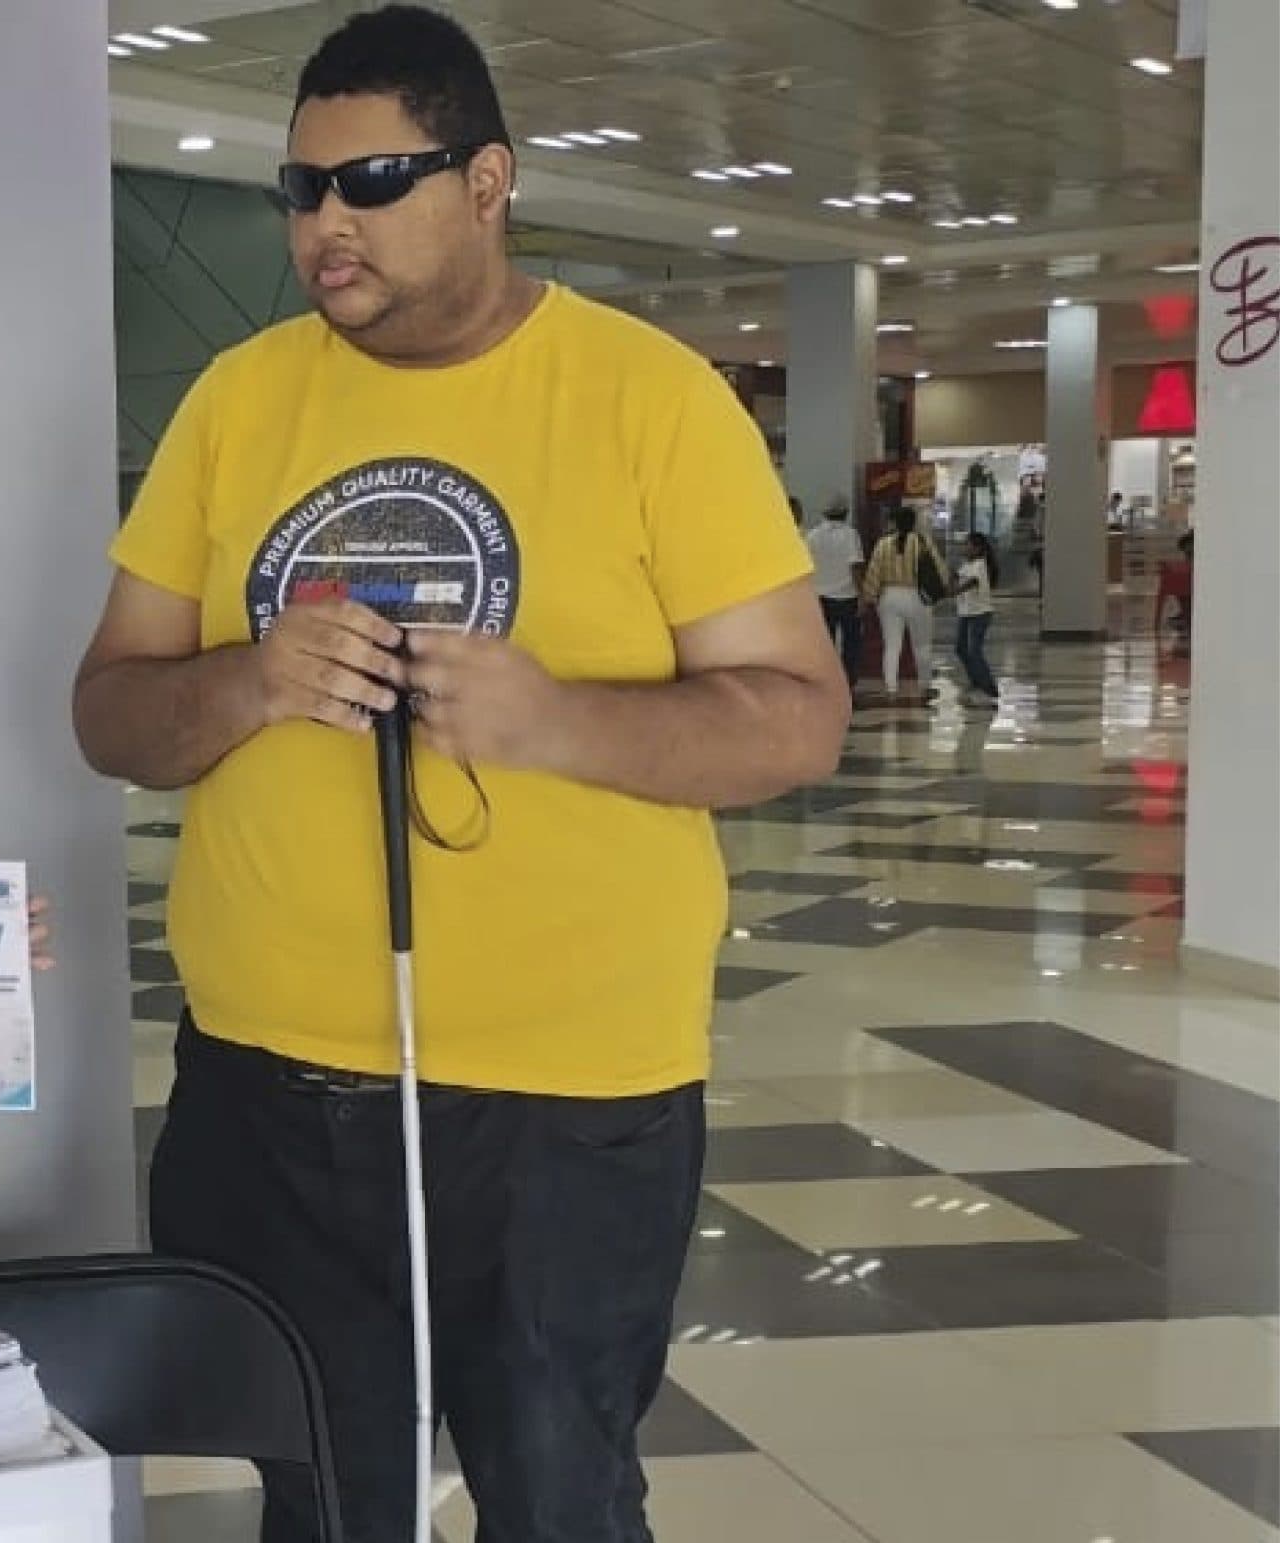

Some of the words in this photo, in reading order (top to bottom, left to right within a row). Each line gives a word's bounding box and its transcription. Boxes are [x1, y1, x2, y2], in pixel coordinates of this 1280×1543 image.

[259, 492, 335, 578] PREMIUM
[342, 466, 434, 499] QUALITY
[437, 475, 508, 554] GARMENT
[481, 577, 509, 638] ORIG
